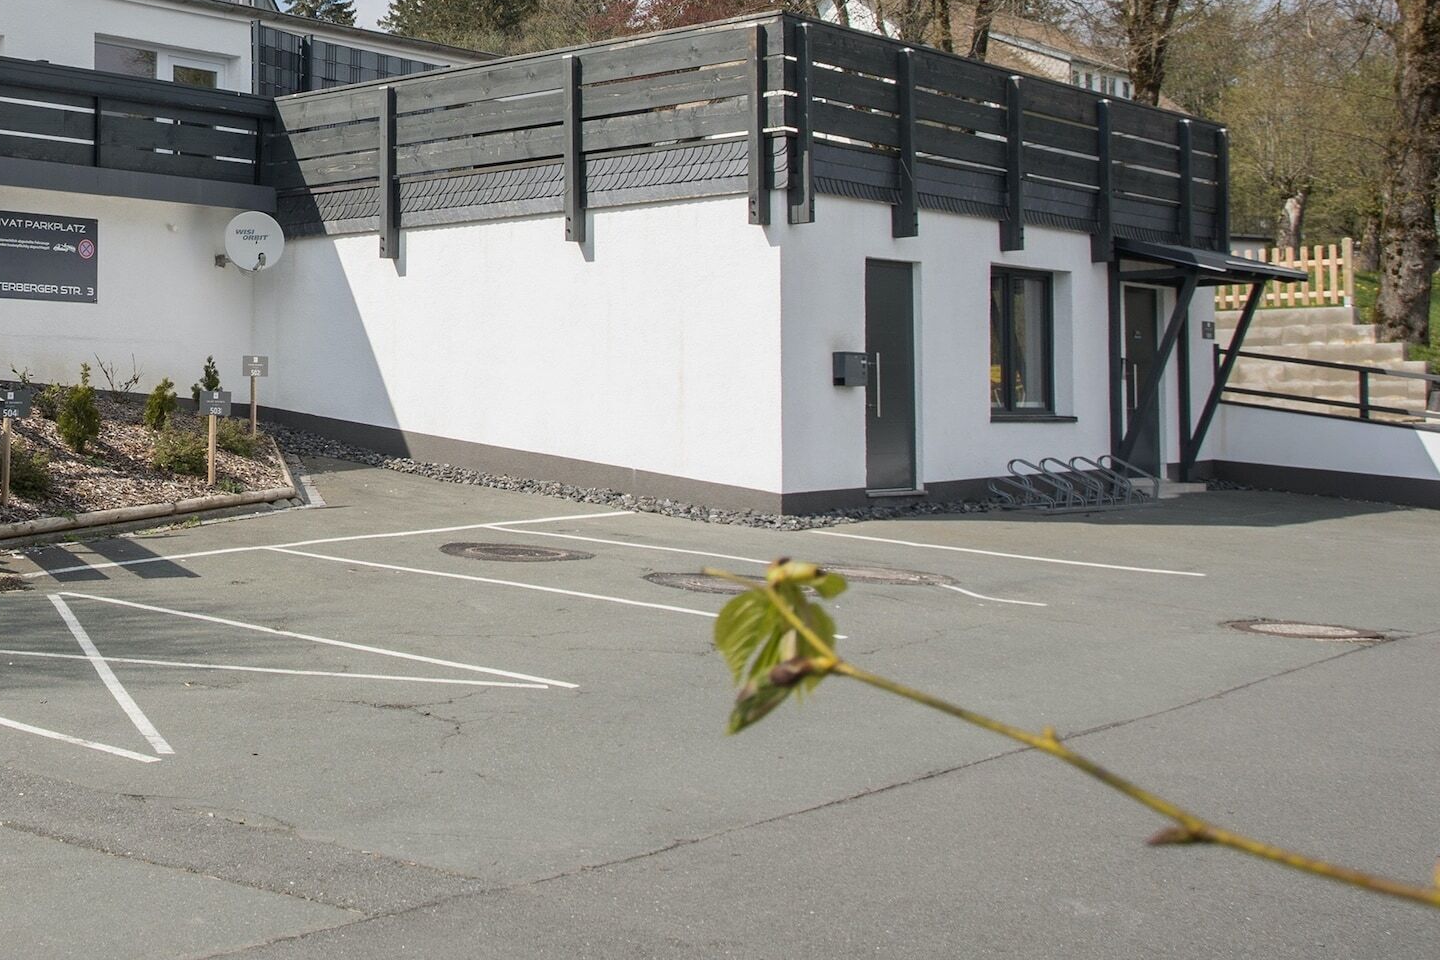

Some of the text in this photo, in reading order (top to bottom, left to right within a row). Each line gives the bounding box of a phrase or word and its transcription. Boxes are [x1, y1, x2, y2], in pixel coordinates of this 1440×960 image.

[25, 220, 86, 233] PARKPLATZ
[60, 286, 83, 296] STR.
[86, 287, 95, 296] 3
[2, 408, 17, 418] 504
[210, 407, 221, 415] 503
